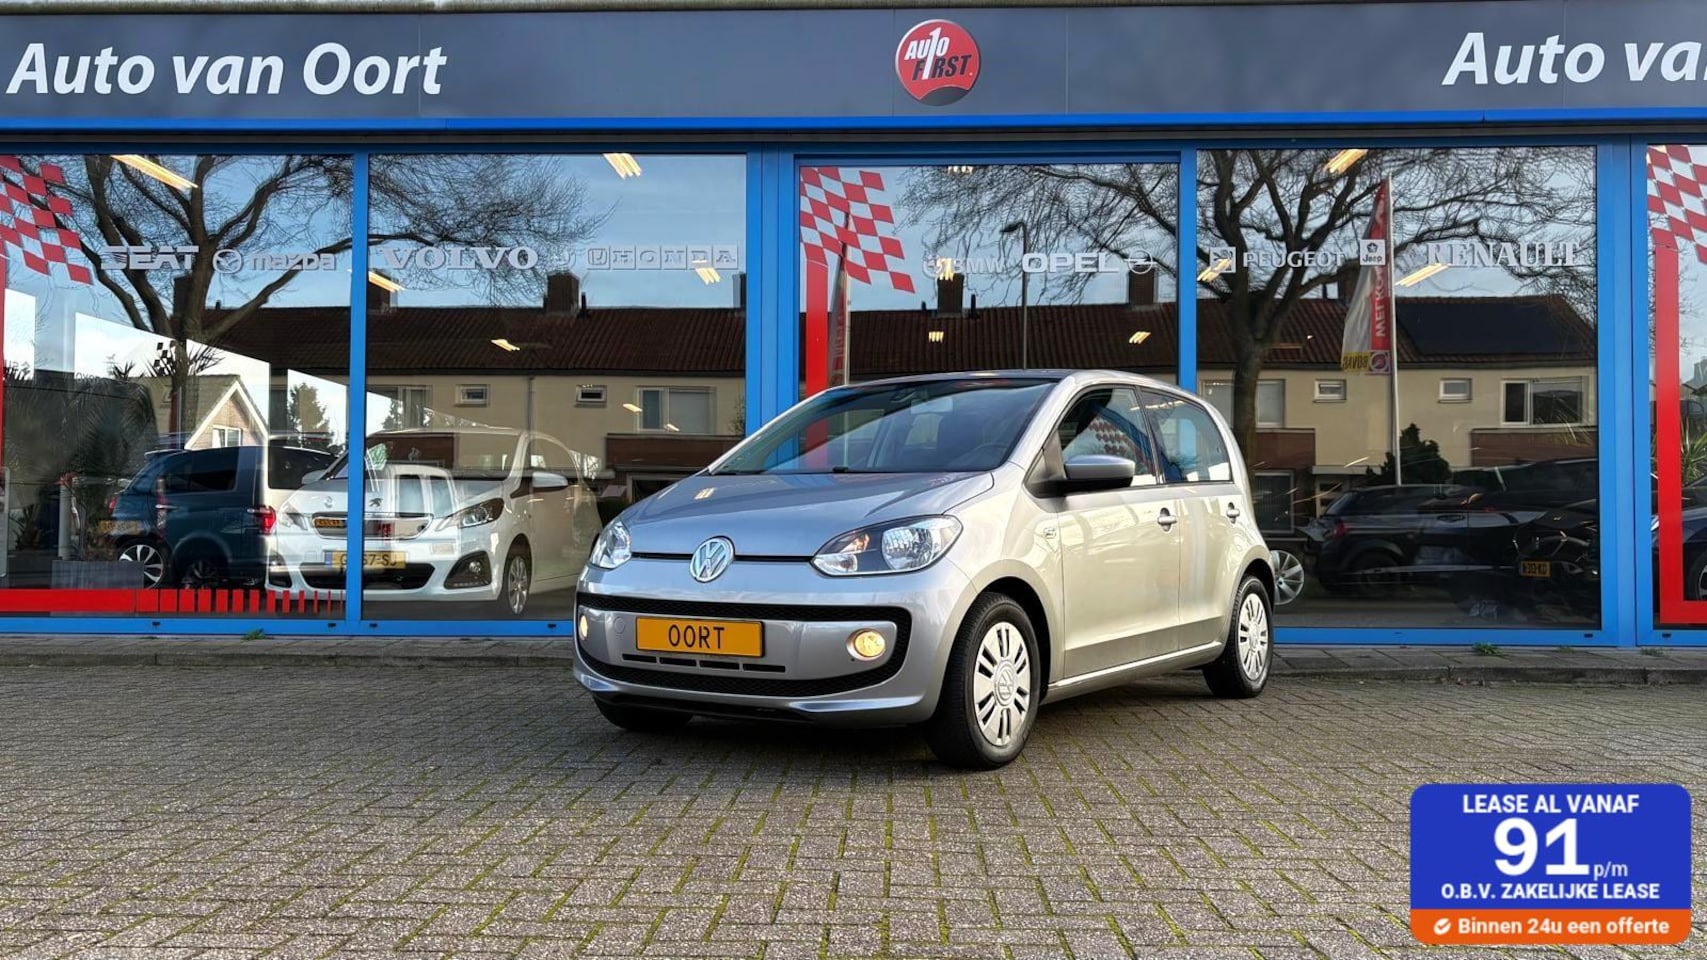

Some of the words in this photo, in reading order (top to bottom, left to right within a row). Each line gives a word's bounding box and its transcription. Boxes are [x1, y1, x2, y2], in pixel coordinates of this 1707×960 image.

[6, 42, 155, 95] Auto
[172, 55, 284, 95] van
[302, 41, 447, 95] Oort
[1441, 32, 1605, 86] Auto
[1624, 41, 1707, 82] va
[101, 245, 200, 270] SEAT
[383, 245, 539, 270] VOLVO
[611, 249, 737, 264] HONDA
[1022, 253, 1120, 273] OPEL
[1243, 250, 1346, 268] PEUGEOT
[1361, 254, 1384, 264] Jeep
[1426, 241, 1581, 268] RENAULT
[668, 624, 725, 649] OORT
